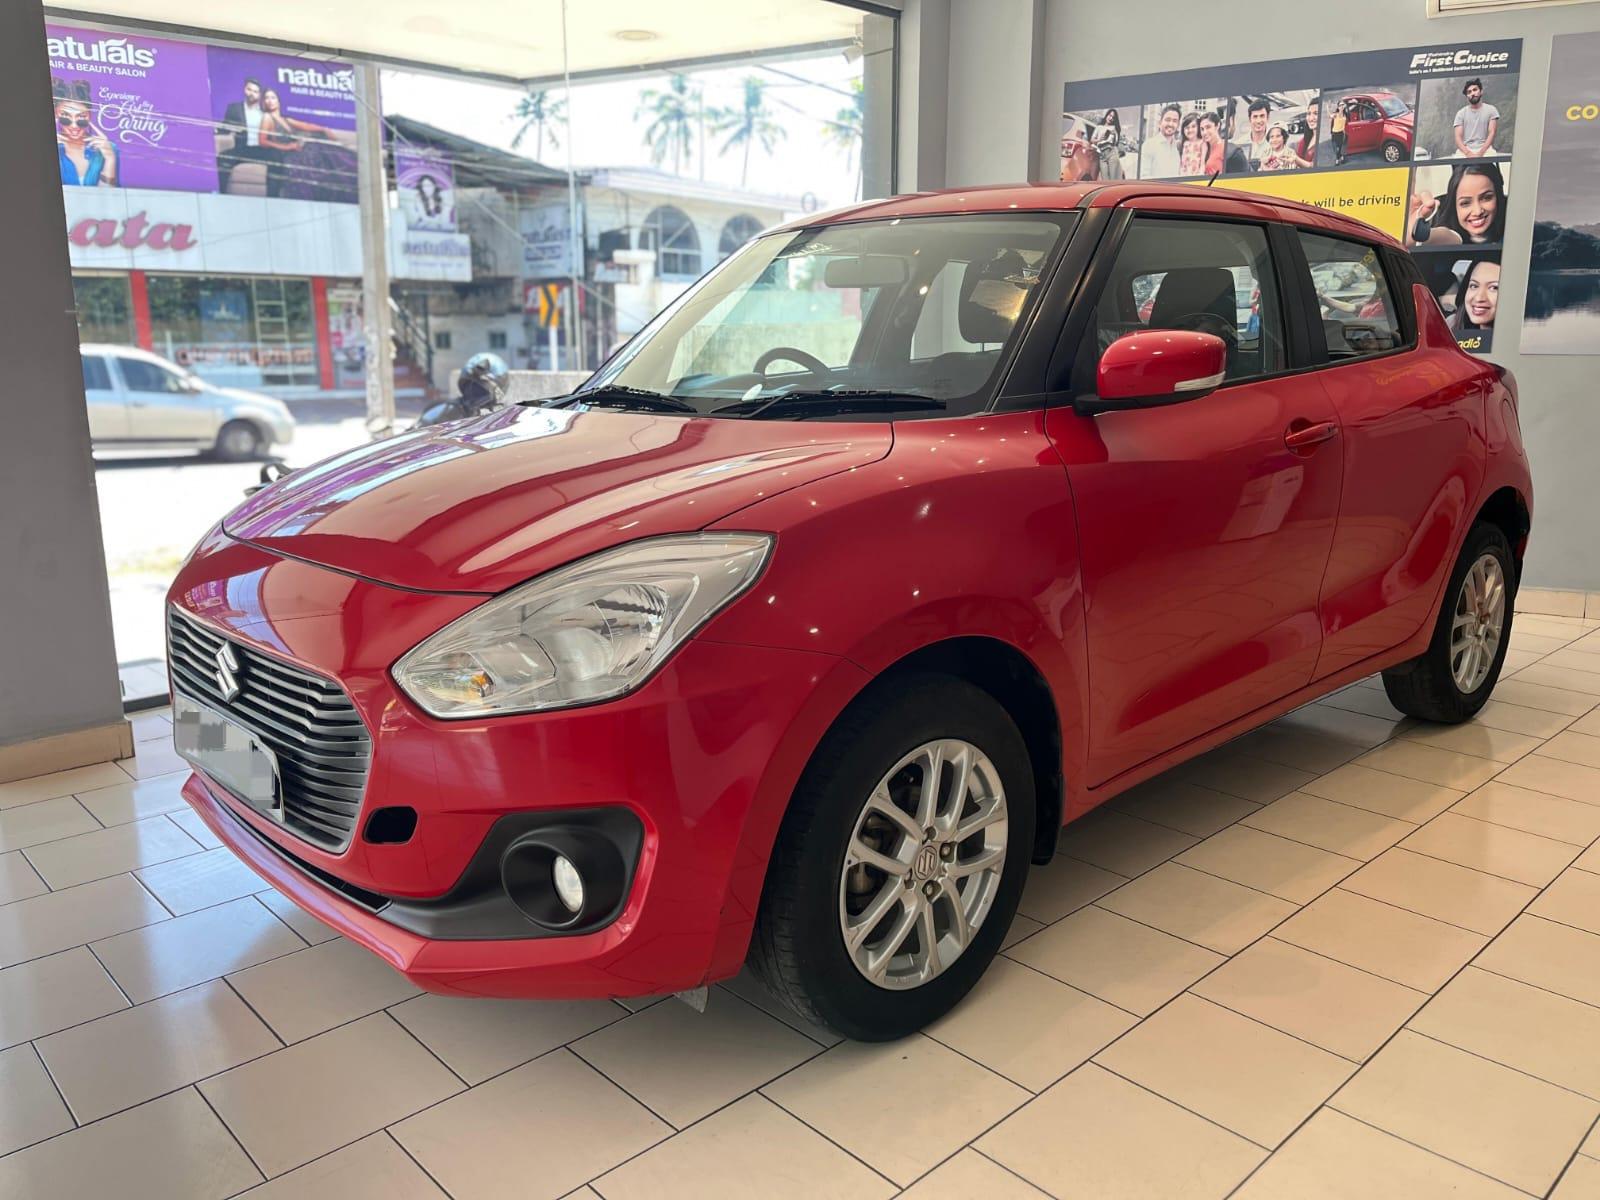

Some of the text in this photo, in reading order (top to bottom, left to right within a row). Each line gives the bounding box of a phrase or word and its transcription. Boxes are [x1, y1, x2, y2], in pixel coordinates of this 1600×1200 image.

[67, 62, 75, 70] &
[76, 63, 113, 75] BEAUTY
[115, 67, 146, 78] SALON
[1314, 198, 1335, 208] will
[1339, 197, 1353, 207] be
[1358, 194, 1401, 206] driving
